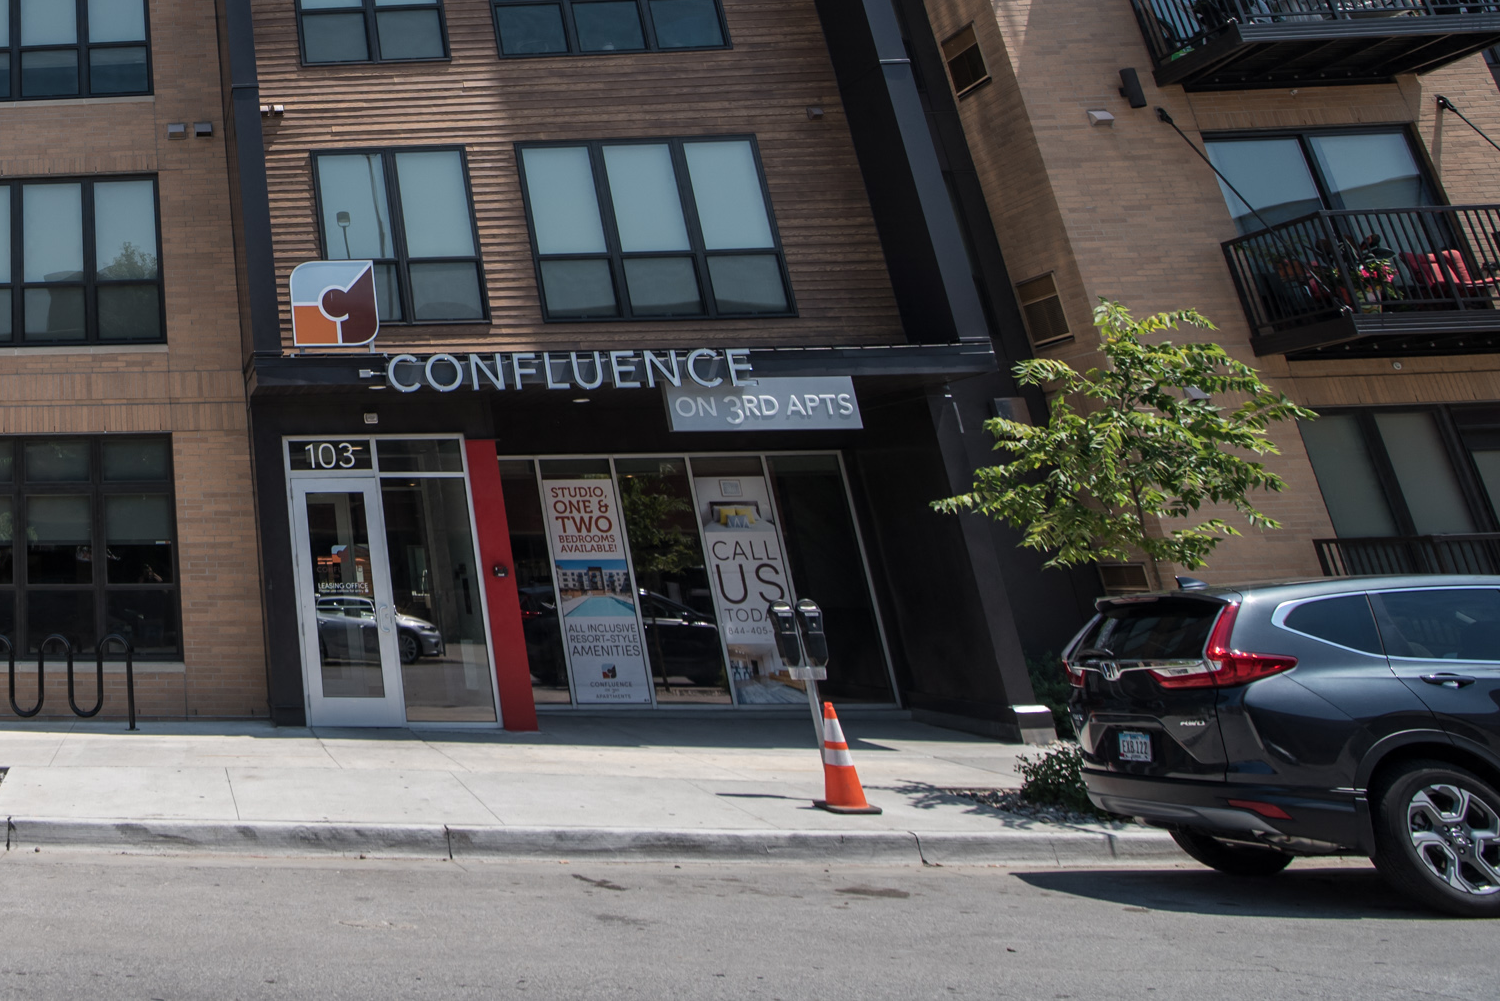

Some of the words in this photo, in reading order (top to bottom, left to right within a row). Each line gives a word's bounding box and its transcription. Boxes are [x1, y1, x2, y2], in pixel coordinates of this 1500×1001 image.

[387, 348, 759, 393] CONFLUENCE
[675, 396, 718, 418] ON
[723, 394, 779, 425] 3RD
[786, 393, 854, 416] APTS
[304, 442, 356, 469] 103
[550, 486, 607, 499] STUDIO,
[553, 499, 593, 514] ONE
[598, 499, 609, 514] &
[555, 515, 613, 534] TWO
[558, 534, 615, 543] BEDROOMS
[560, 544, 617, 553] AVAILABLE!
[712, 540, 778, 561] CALL
[715, 563, 786, 604] US
[724, 608, 771, 622] TOD
[568, 623, 585, 633] ALL
[587, 623, 636, 633] INCLUSIVE
[728, 627, 773, 635] 844-405-
[570, 634, 639, 644] RESORT-STYLE
[572, 645, 641, 657] AMENITIES
[1135, 740, 1148, 755] 122
